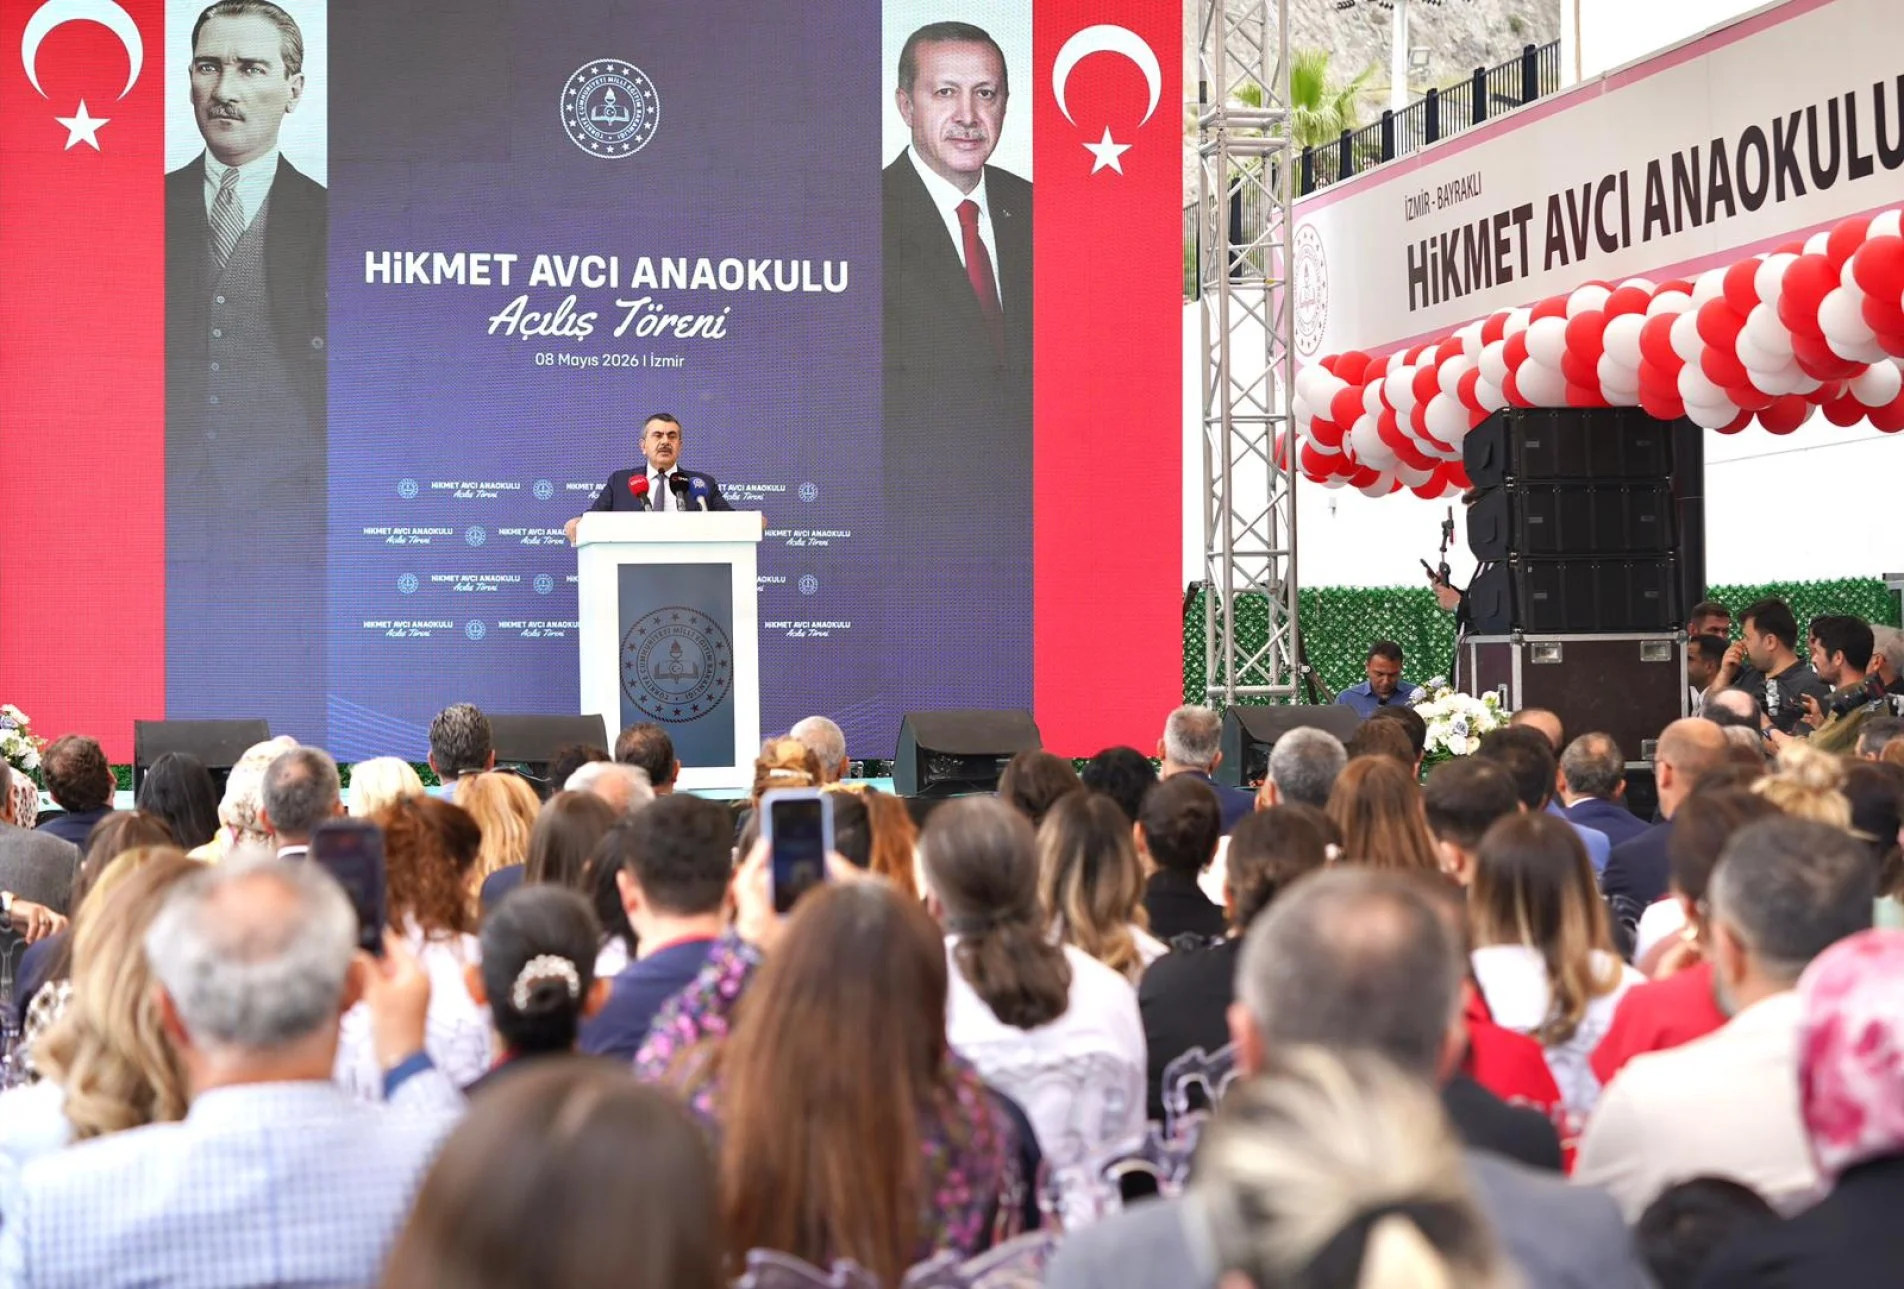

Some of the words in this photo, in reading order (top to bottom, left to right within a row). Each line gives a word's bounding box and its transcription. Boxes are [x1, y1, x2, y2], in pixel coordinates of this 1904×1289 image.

[1405, 188, 1430, 221] İZMİR
[1437, 171, 1481, 210] BAYRAKLI
[1544, 170, 1631, 271] AVCI
[1642, 74, 1904, 242] ANAOKULU
[529, 254, 618, 289] AVCI
[632, 257, 848, 293] ANAOKULU
[487, 294, 598, 341] Açılış
[613, 296, 730, 339] Töreni
[535, 352, 554, 366] 08
[558, 352, 599, 369] Mayıs
[602, 353, 639, 367] 2026
[650, 351, 685, 367] İzmir
